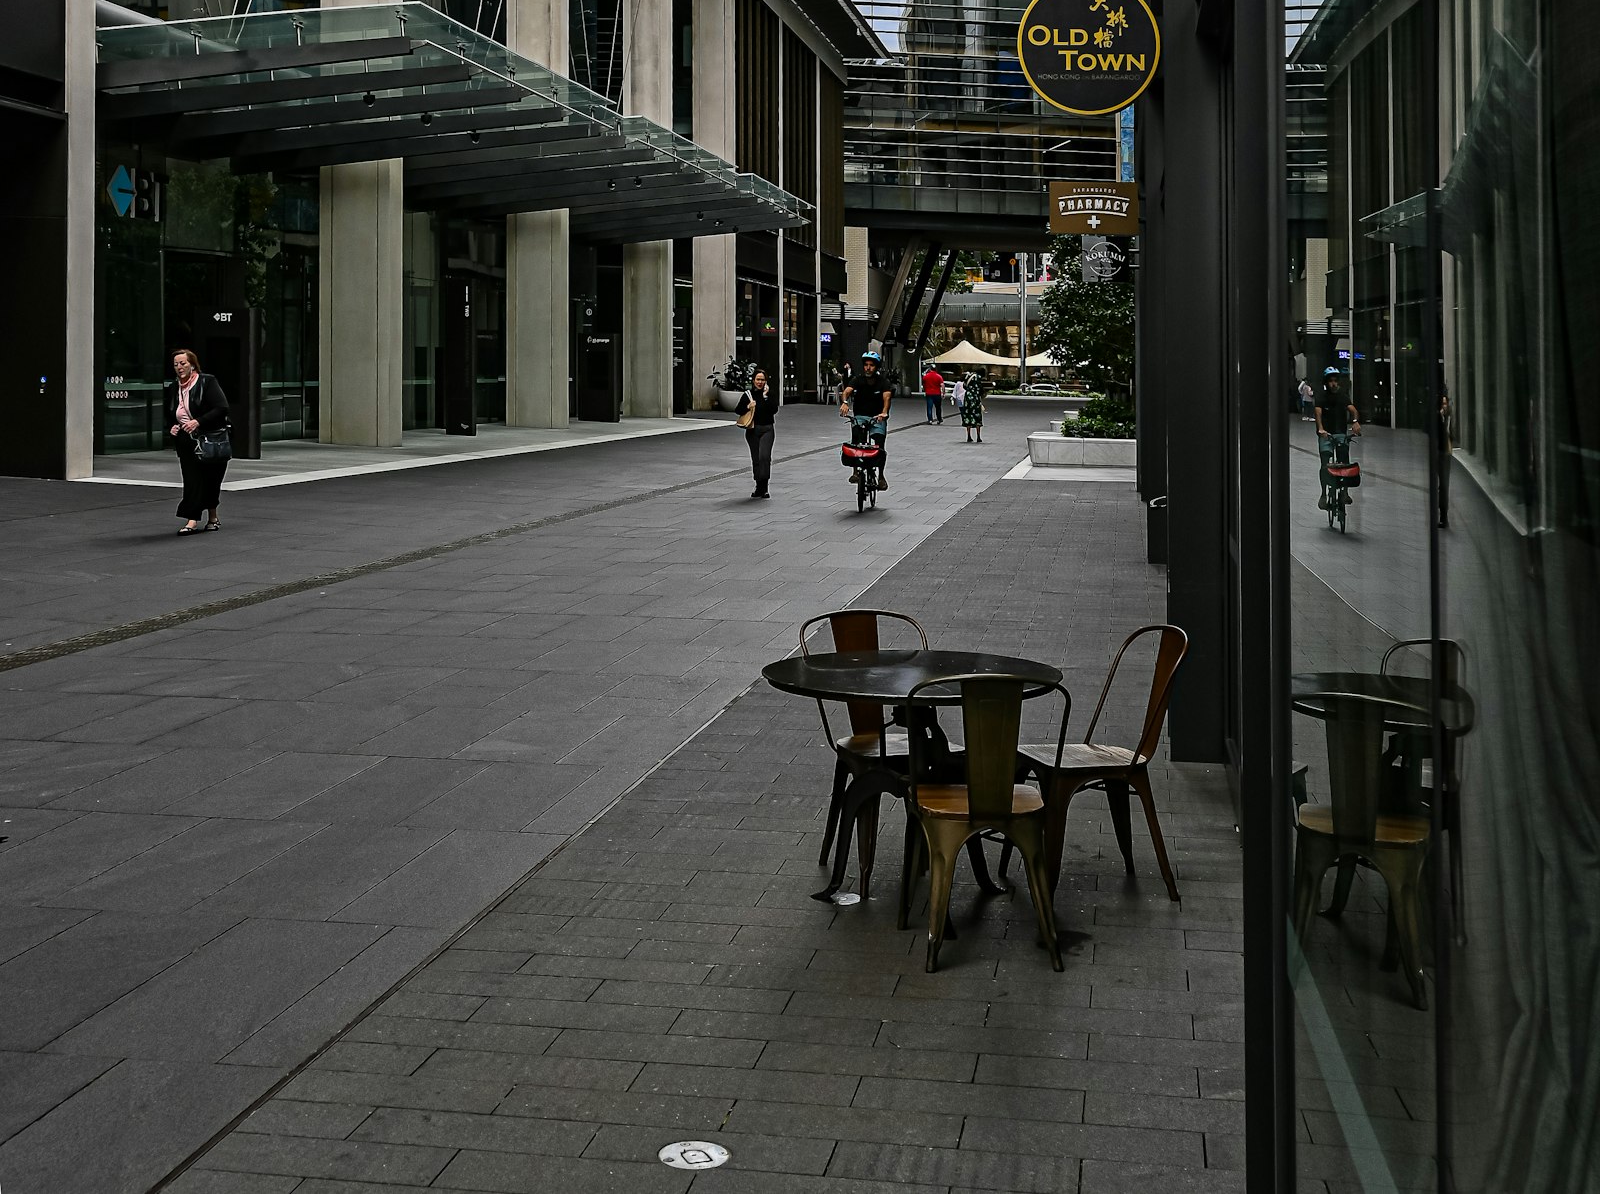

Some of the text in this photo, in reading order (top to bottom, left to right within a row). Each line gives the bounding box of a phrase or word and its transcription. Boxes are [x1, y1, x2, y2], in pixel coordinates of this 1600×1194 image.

[1027, 24, 1089, 47] OLD
[1058, 49, 1146, 72] TOWN
[1037, 73, 1059, 81] HONG
[1060, 73, 1081, 81] KONG
[1058, 198, 1130, 213] PHARMACY
[220, 312, 233, 323] BT
